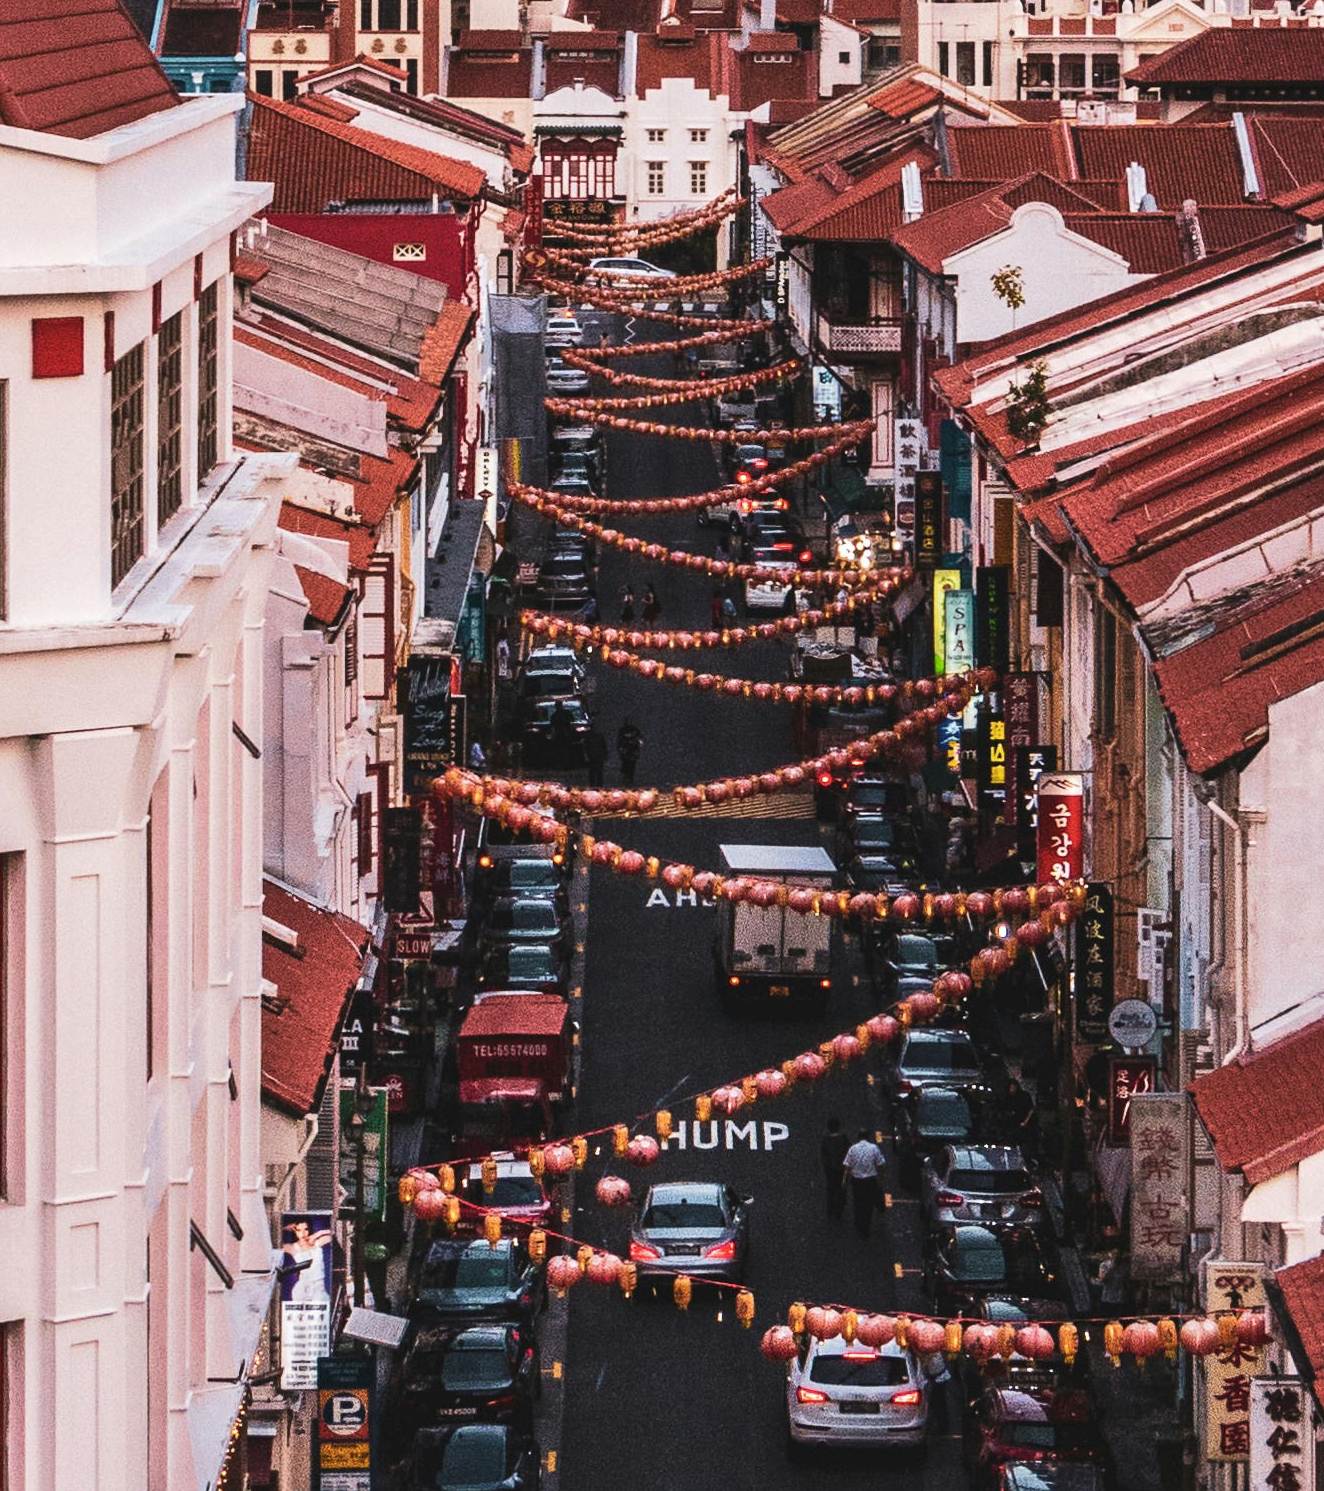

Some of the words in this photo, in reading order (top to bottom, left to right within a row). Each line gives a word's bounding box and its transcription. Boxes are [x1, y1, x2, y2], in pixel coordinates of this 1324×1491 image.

[953, 607, 966, 652] SPA
[1049, 803, 1073, 887] 금강원
[397, 940, 432, 954] SLOW
[660, 1120, 790, 1151] HUMP
